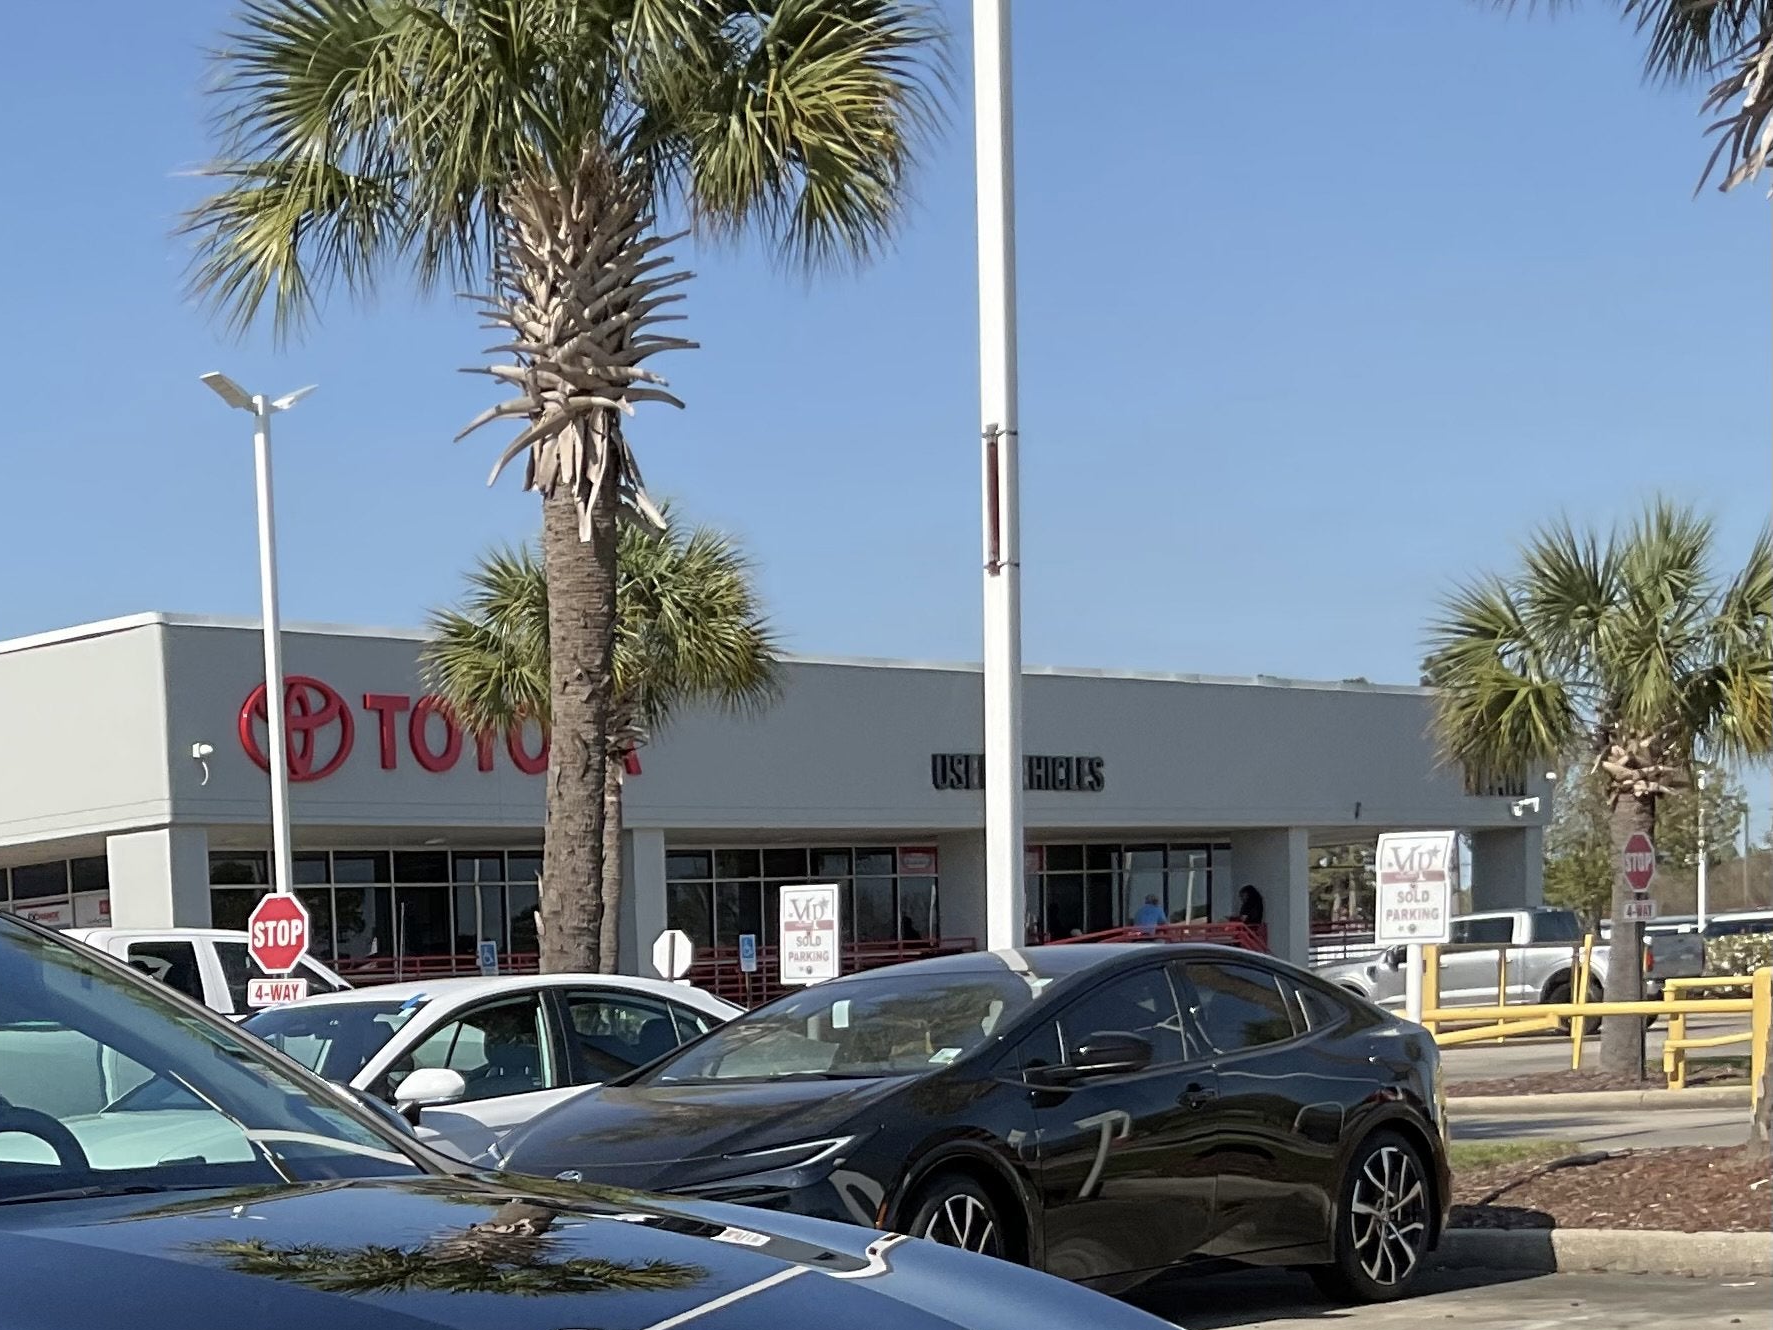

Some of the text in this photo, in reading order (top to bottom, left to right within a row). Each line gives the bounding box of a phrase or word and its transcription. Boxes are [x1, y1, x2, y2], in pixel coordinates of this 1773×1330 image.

[363, 693, 642, 775] TOO
[931, 754, 1104, 791] USE HICLES
[1625, 852, 1652, 872] STOP
[1397, 890, 1430, 904] SOLD
[1386, 908, 1439, 921] PARKING
[253, 918, 303, 948] STOP
[795, 935, 822, 947] SOLD
[788, 951, 829, 962] PARKING
[255, 983, 299, 1001] 4-WAY
